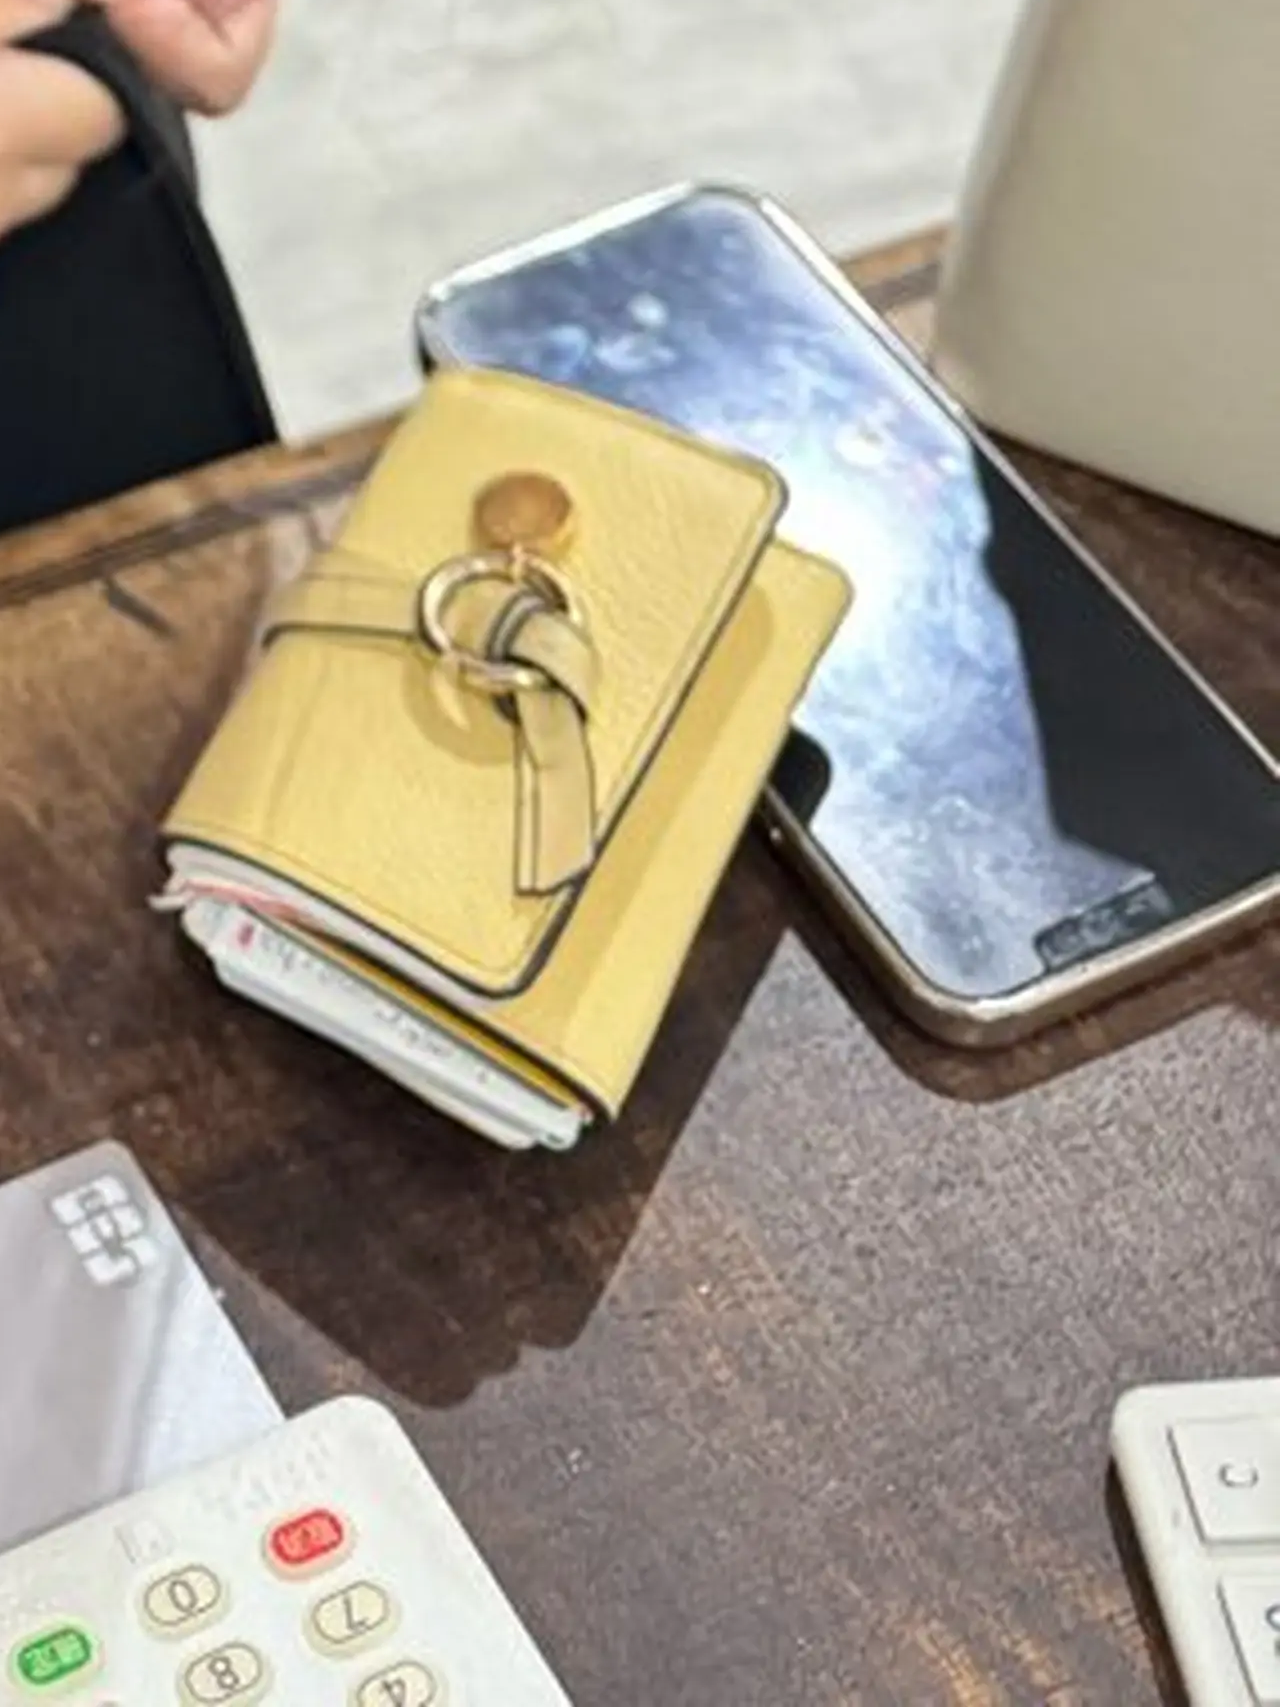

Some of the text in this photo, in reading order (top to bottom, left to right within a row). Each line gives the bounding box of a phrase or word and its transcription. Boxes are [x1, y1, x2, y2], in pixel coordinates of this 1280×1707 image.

[170, 1580, 197, 1613] 0
[344, 1598, 370, 1631] 7
[209, 1656, 239, 1691] 8
